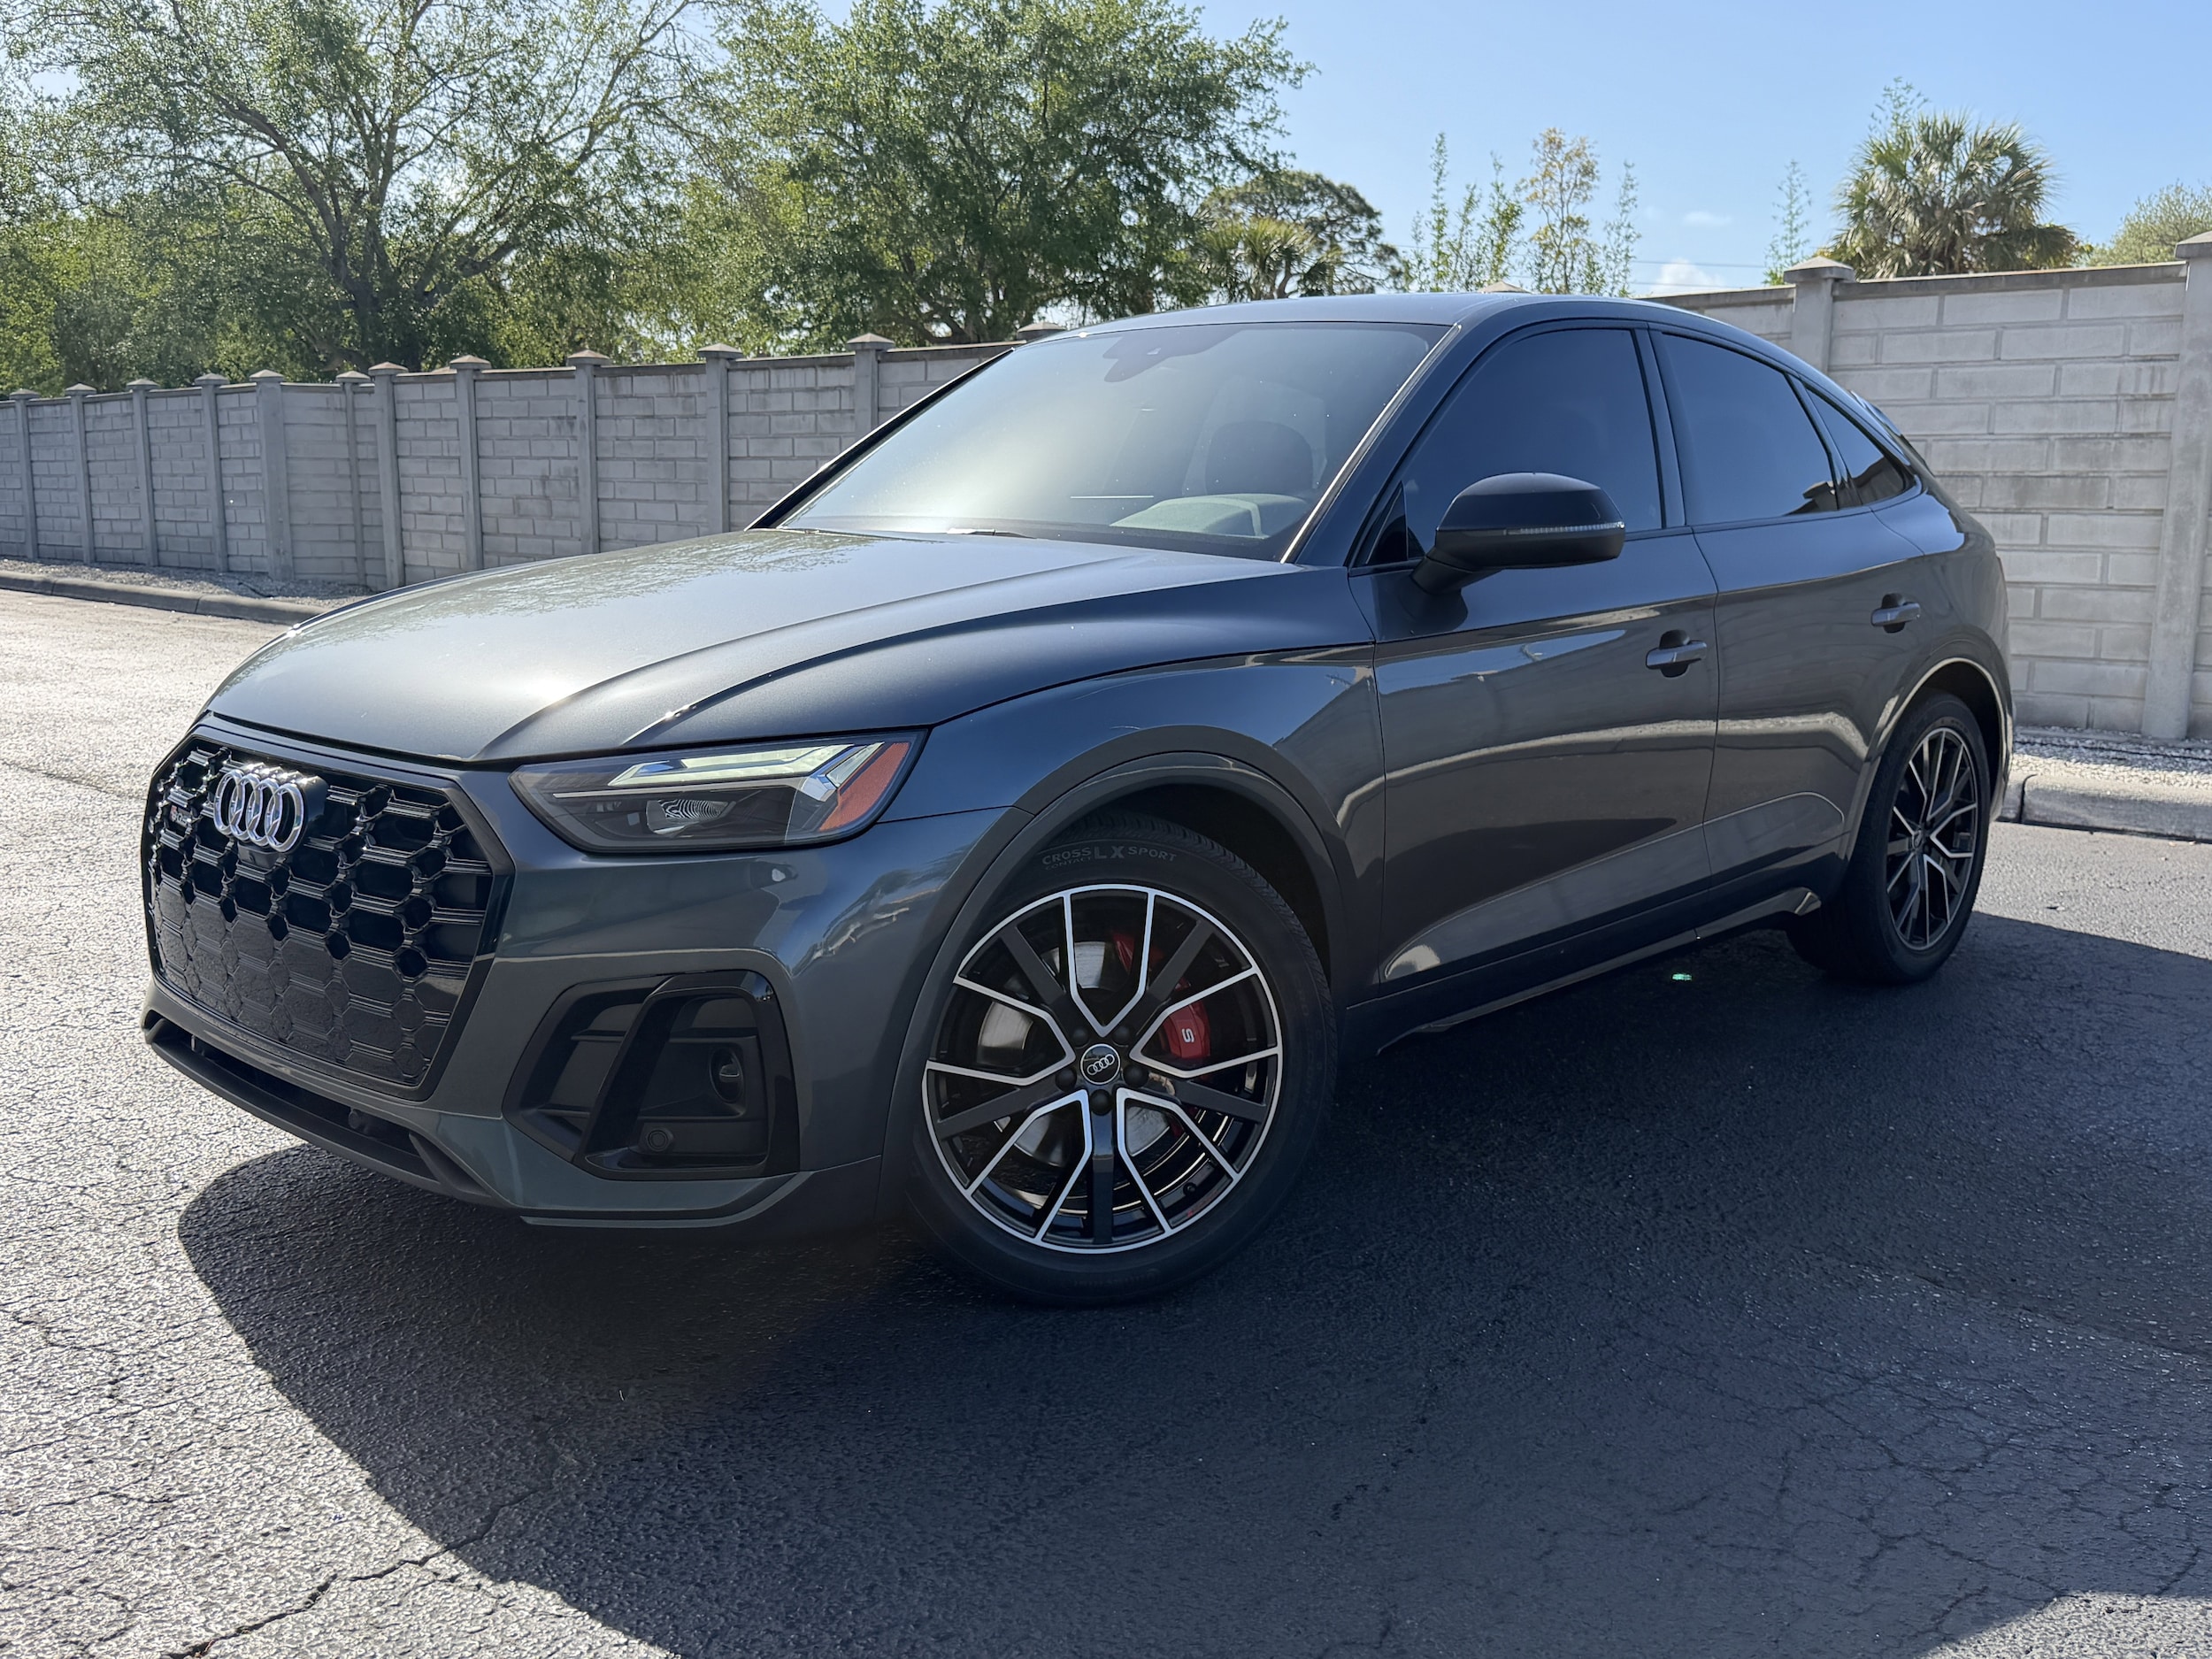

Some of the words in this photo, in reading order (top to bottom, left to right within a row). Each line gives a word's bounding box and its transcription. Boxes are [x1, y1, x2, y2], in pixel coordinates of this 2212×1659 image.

[1042, 847, 1092, 864] CROSS
[1128, 846, 1177, 862] SPORT
[1181, 1028, 1194, 1042] S
